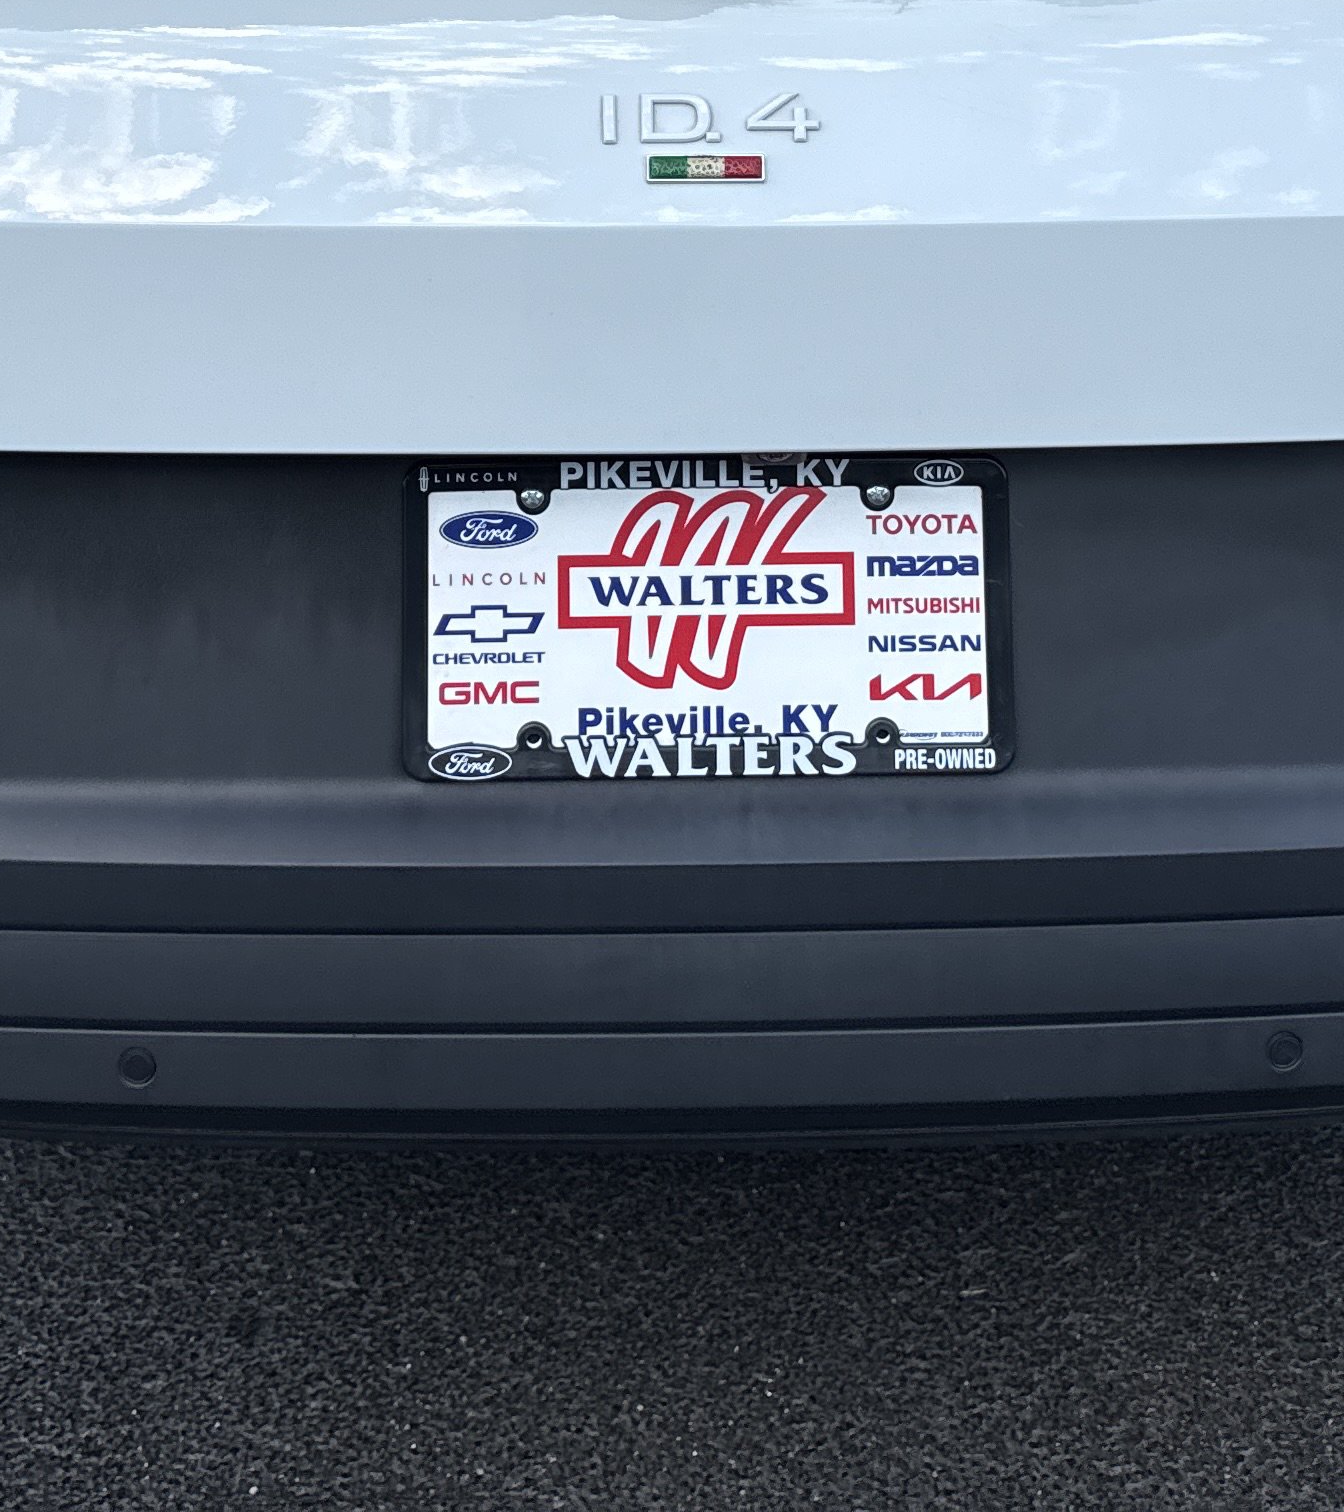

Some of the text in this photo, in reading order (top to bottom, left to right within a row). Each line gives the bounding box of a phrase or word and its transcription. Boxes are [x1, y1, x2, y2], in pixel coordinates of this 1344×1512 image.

[434, 471, 518, 484] LINCOLN
[560, 458, 850, 494] PIKEVILLE, KY
[922, 465, 957, 480] KIA
[459, 516, 518, 542] Ford
[865, 513, 978, 535] TOYOTA
[432, 571, 546, 587] LINCOLN
[587, 572, 829, 607] WALTERS
[867, 596, 981, 615] MITSUBISHI
[867, 634, 982, 653] NISSAN
[432, 651, 546, 665] CHEVROLET
[438, 680, 540, 706] GMC
[869, 673, 982, 701] KIA
[781, 703, 839, 734] KY
[444, 752, 496, 774] Ford
[563, 735, 857, 778] WALTERS
[894, 748, 997, 770] PRE-OWNED
